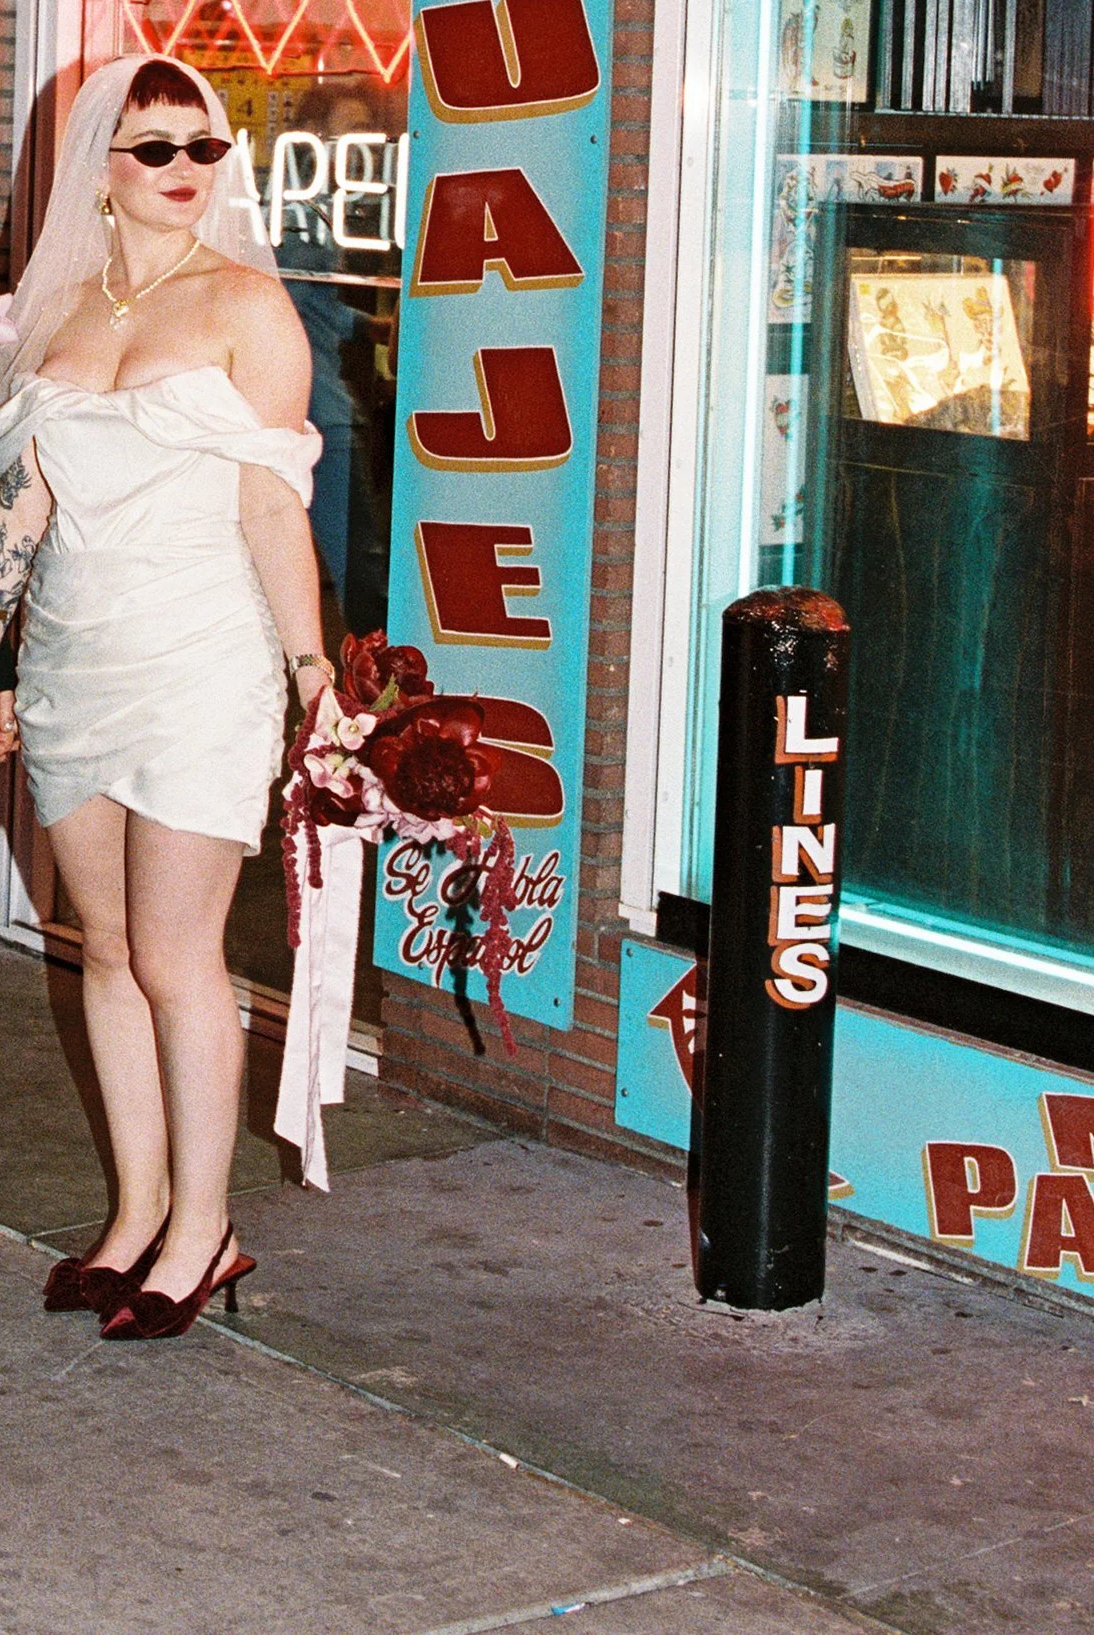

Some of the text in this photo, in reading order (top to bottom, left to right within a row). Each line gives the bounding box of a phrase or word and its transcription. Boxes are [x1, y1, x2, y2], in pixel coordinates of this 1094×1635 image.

[383, 838, 566, 910] Se Hbla
[765, 690, 839, 1010] LINES
[400, 897, 554, 989] Espaol
